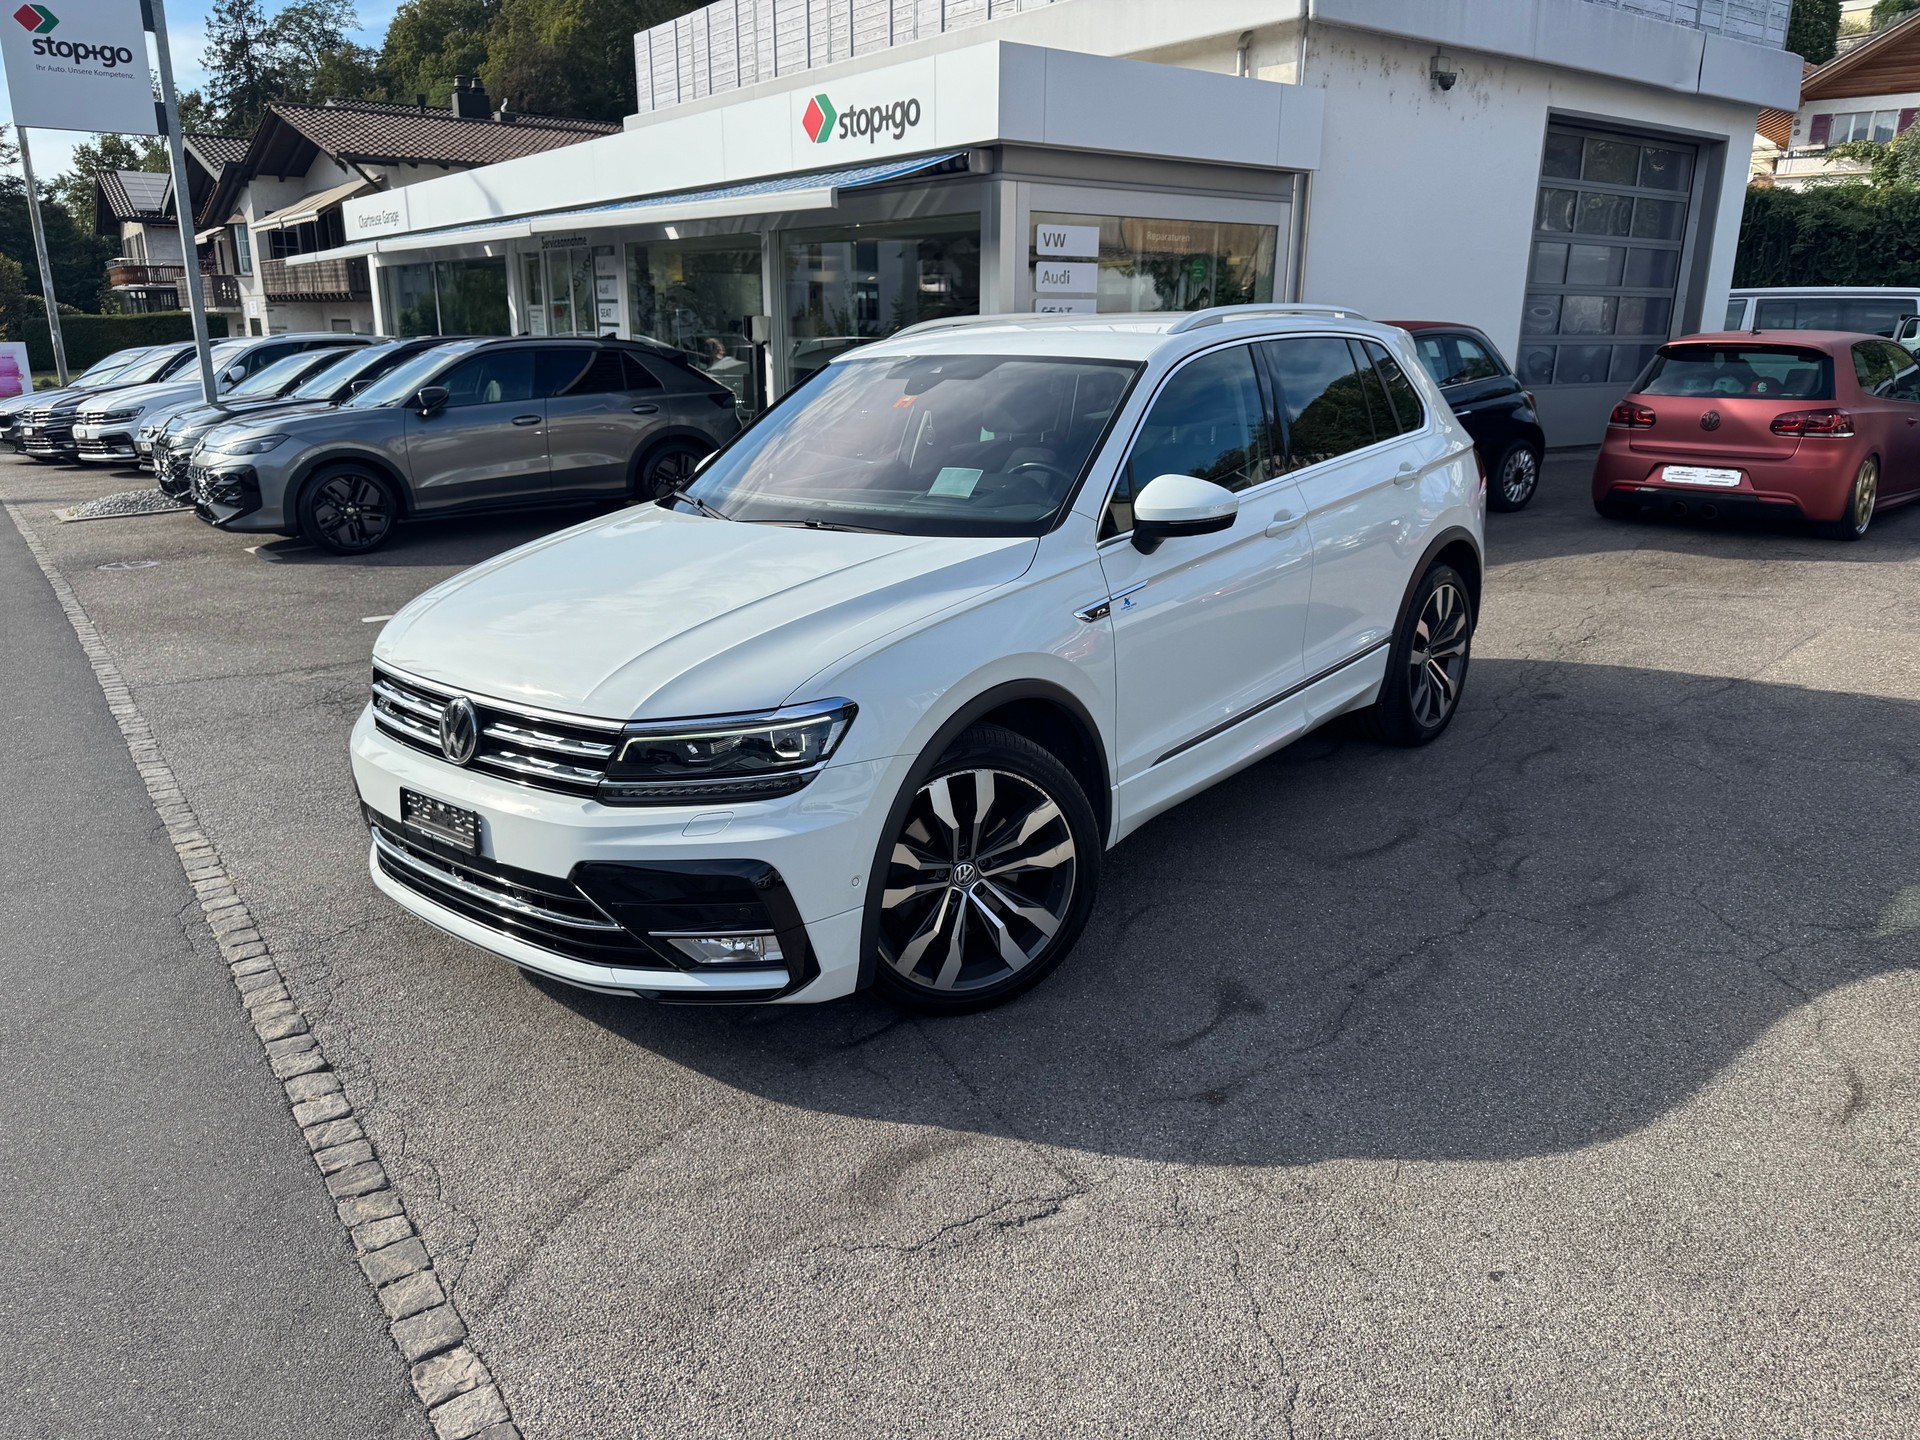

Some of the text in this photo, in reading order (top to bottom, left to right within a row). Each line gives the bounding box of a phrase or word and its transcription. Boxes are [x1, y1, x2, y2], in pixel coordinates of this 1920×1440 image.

[32, 36, 133, 68] stop+go
[36, 63, 136, 79] Ihr Auto. Unsere Kompetenz.
[839, 98, 921, 144] stop+go
[382, 210, 399, 226] Garage
[541, 232, 588, 249] Serviceannahme
[1043, 232, 1066, 248] VW
[1146, 231, 1190, 243] Reparaturen
[1042, 270, 1070, 284] Audi
[600, 307, 612, 318] SEAT
